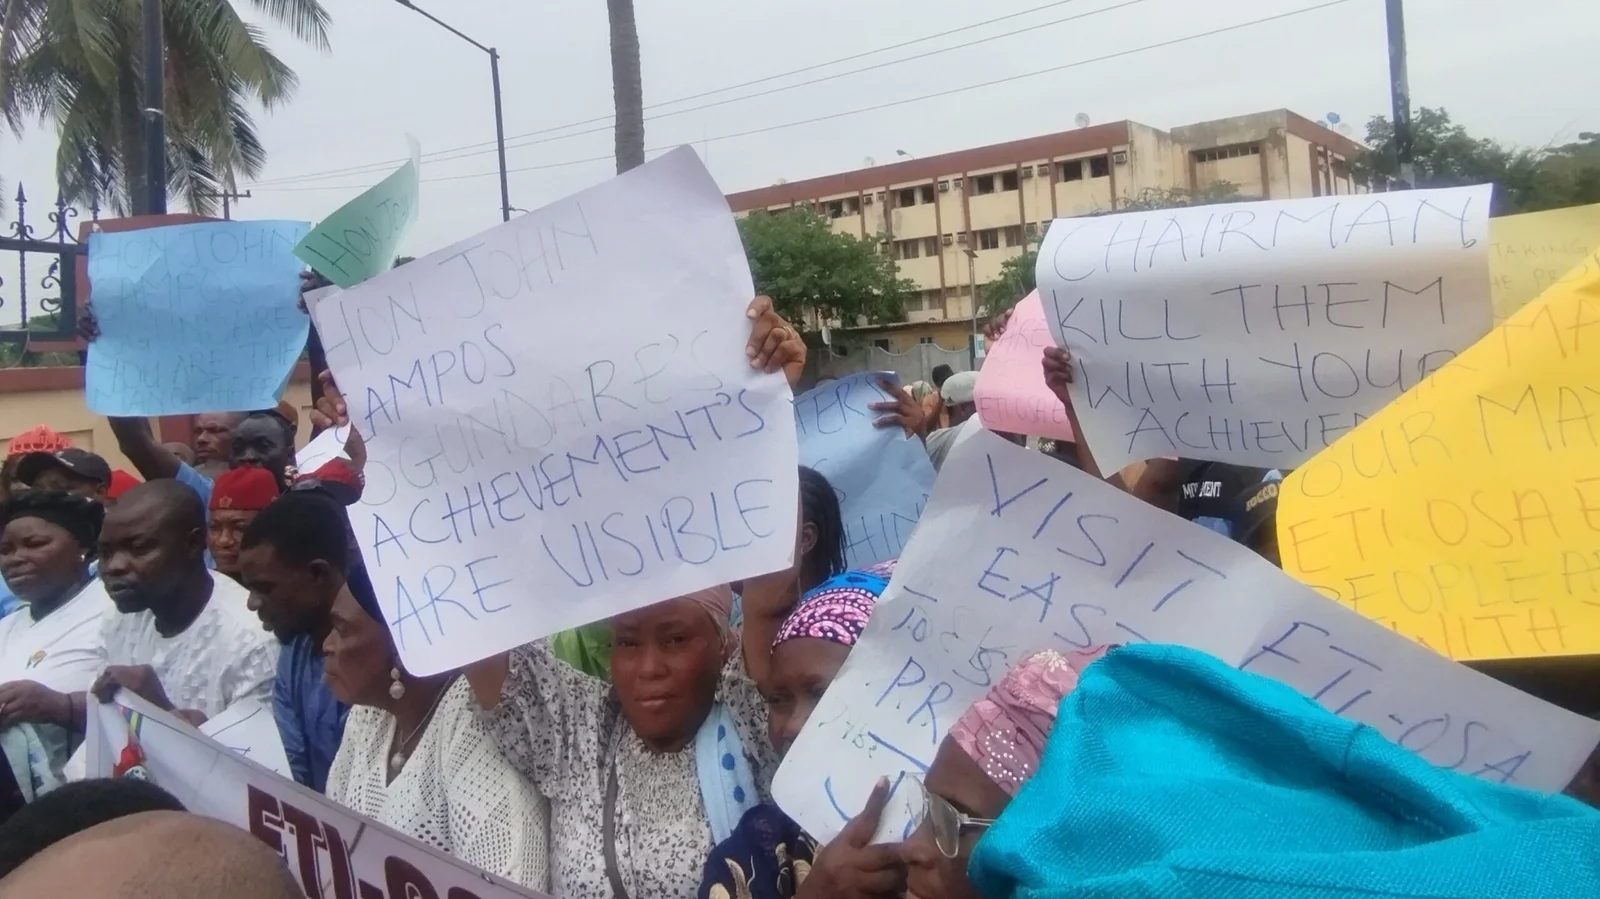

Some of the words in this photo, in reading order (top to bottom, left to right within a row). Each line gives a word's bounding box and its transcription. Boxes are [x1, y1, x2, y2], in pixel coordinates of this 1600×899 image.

[93, 230, 168, 272] HON
[178, 226, 298, 268] JOHN
[323, 281, 425, 371] HON
[439, 202, 598, 320] JOHN
[1053, 289, 1201, 352] KILL
[1212, 276, 1445, 334] THEM
[91, 355, 160, 392] YOU
[172, 348, 226, 382] ARE
[1079, 358, 1236, 409] WITH
[372, 389, 765, 567] ACHIEVEMENT'S
[1301, 411, 1452, 497] OUR
[392, 555, 512, 651] ARE
[540, 479, 774, 588] VISIBLE
[986, 453, 1227, 613] VISIT
[1288, 507, 1394, 574] ETI
[1426, 489, 1562, 548] OSA
